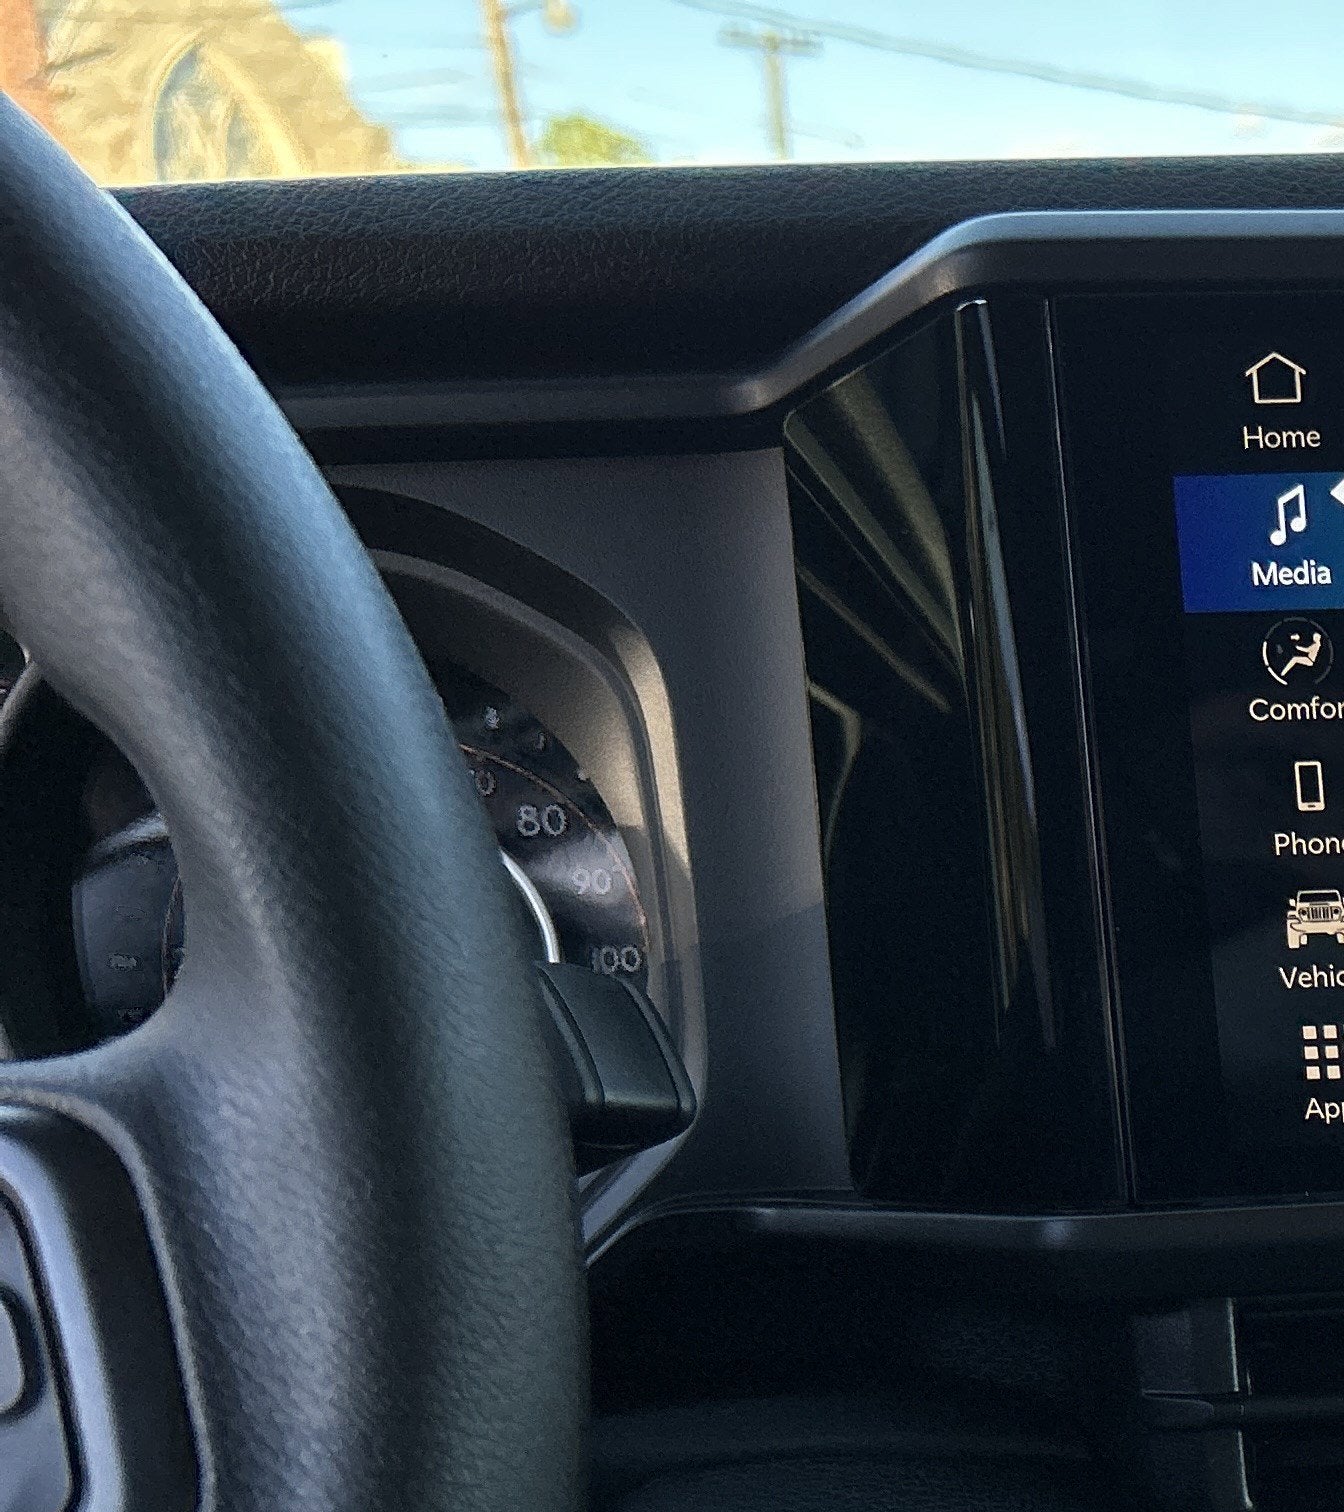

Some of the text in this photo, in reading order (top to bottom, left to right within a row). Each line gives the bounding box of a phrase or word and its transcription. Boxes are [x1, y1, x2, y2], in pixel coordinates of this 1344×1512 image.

[1243, 425, 1321, 449] Home
[1252, 560, 1331, 587] Media
[517, 804, 568, 836] 80
[572, 868, 612, 895] 90
[591, 946, 642, 975] 100
